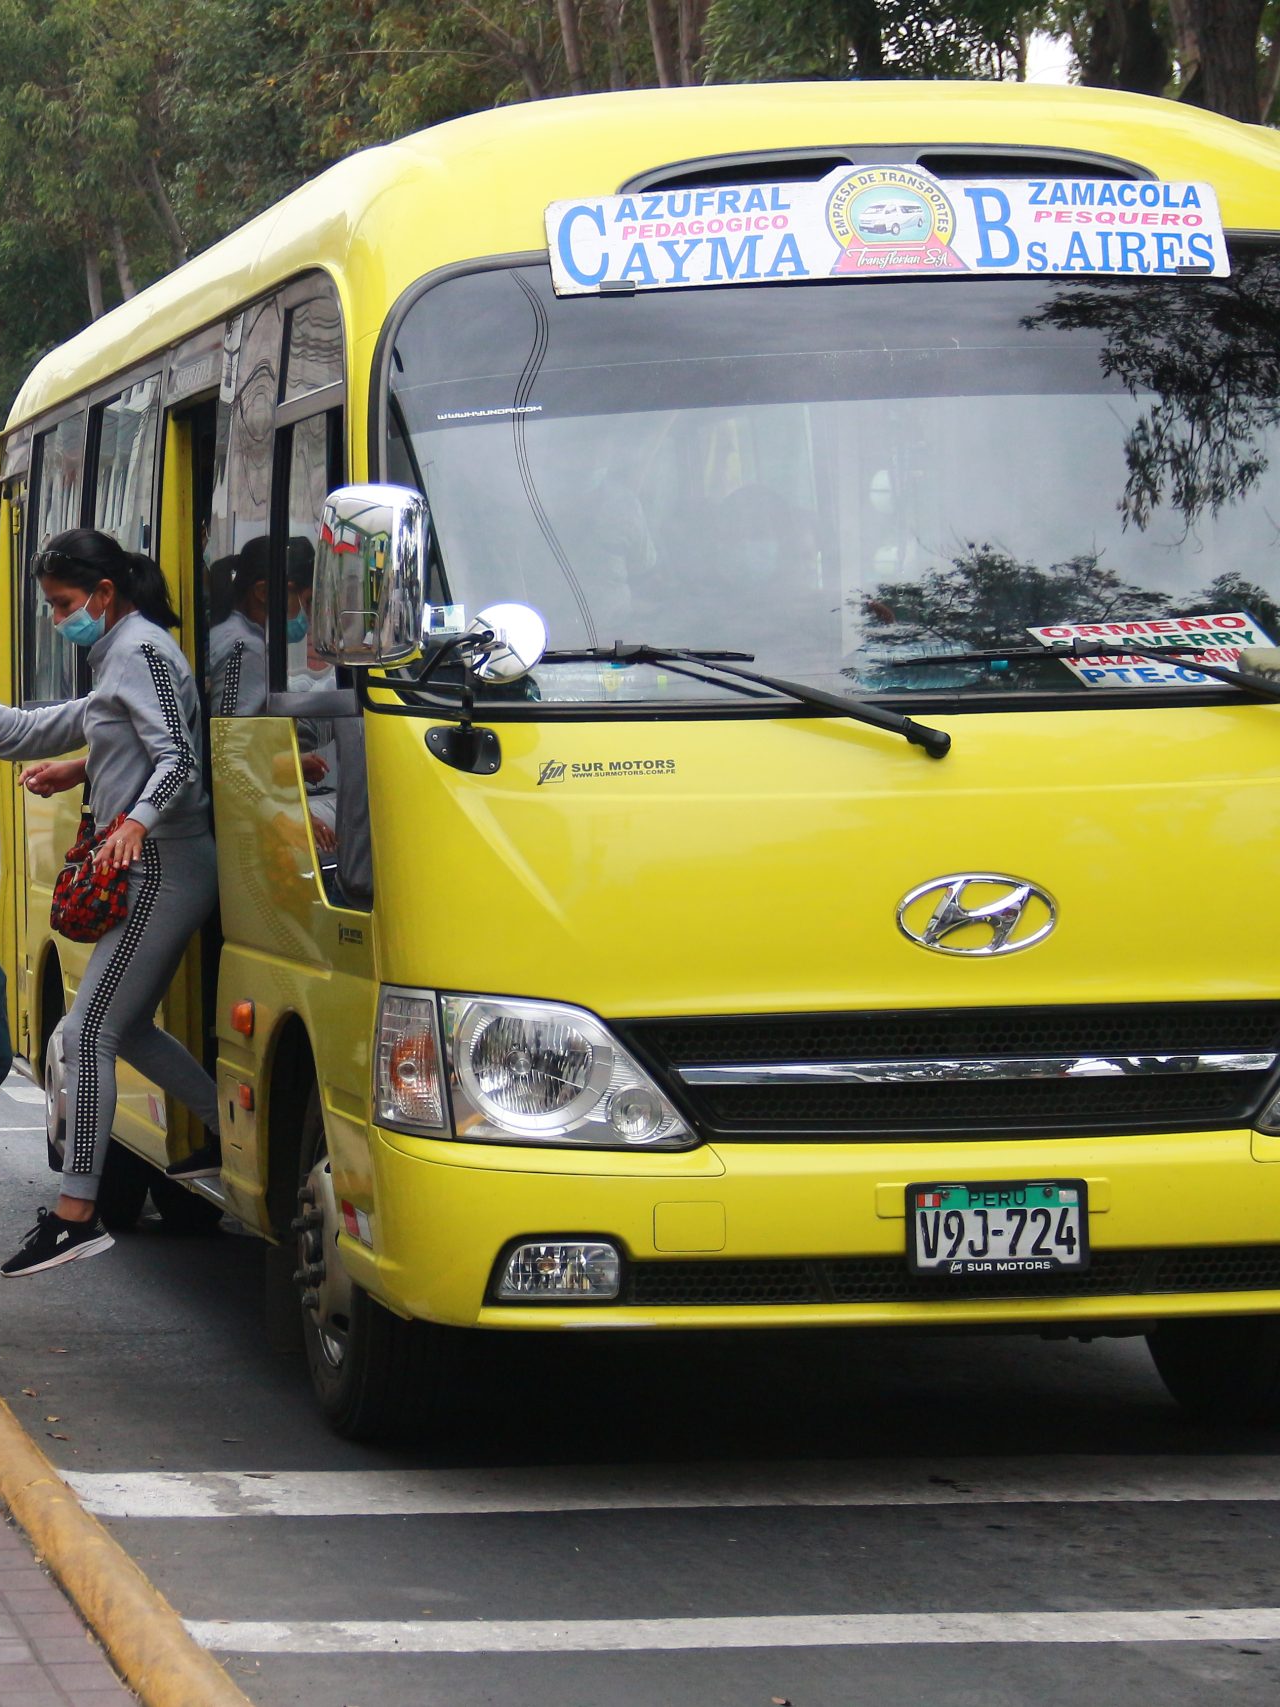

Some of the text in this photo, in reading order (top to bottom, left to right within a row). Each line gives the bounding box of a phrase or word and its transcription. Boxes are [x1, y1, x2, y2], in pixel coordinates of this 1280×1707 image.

[614, 186, 791, 223] AZUFRAL
[832, 171, 949, 237] EMPRESA DE TRANSPORTES
[1028, 182, 1202, 209] ZAMACOLA
[622, 214, 789, 241] PEDAGOGICO
[1034, 210, 1203, 227] PESQUERO
[558, 204, 810, 287] CAYMA
[846, 245, 926, 269] Transflorian
[1040, 615, 1247, 639] ORMEÑO
[1050, 631, 1256, 648] AVERRY
[1194, 647, 1244, 663] ARM
[1080, 665, 1229, 684] PTE-G
[571, 759, 676, 773] SUR MOTORS
[571, 768, 676, 779] WWW.SURMOTORS.COM.PE
[969, 1190, 1027, 1207] PERU
[920, 1207, 1077, 1259] V9J-724
[967, 1261, 1052, 1272] SUR MOTORS
